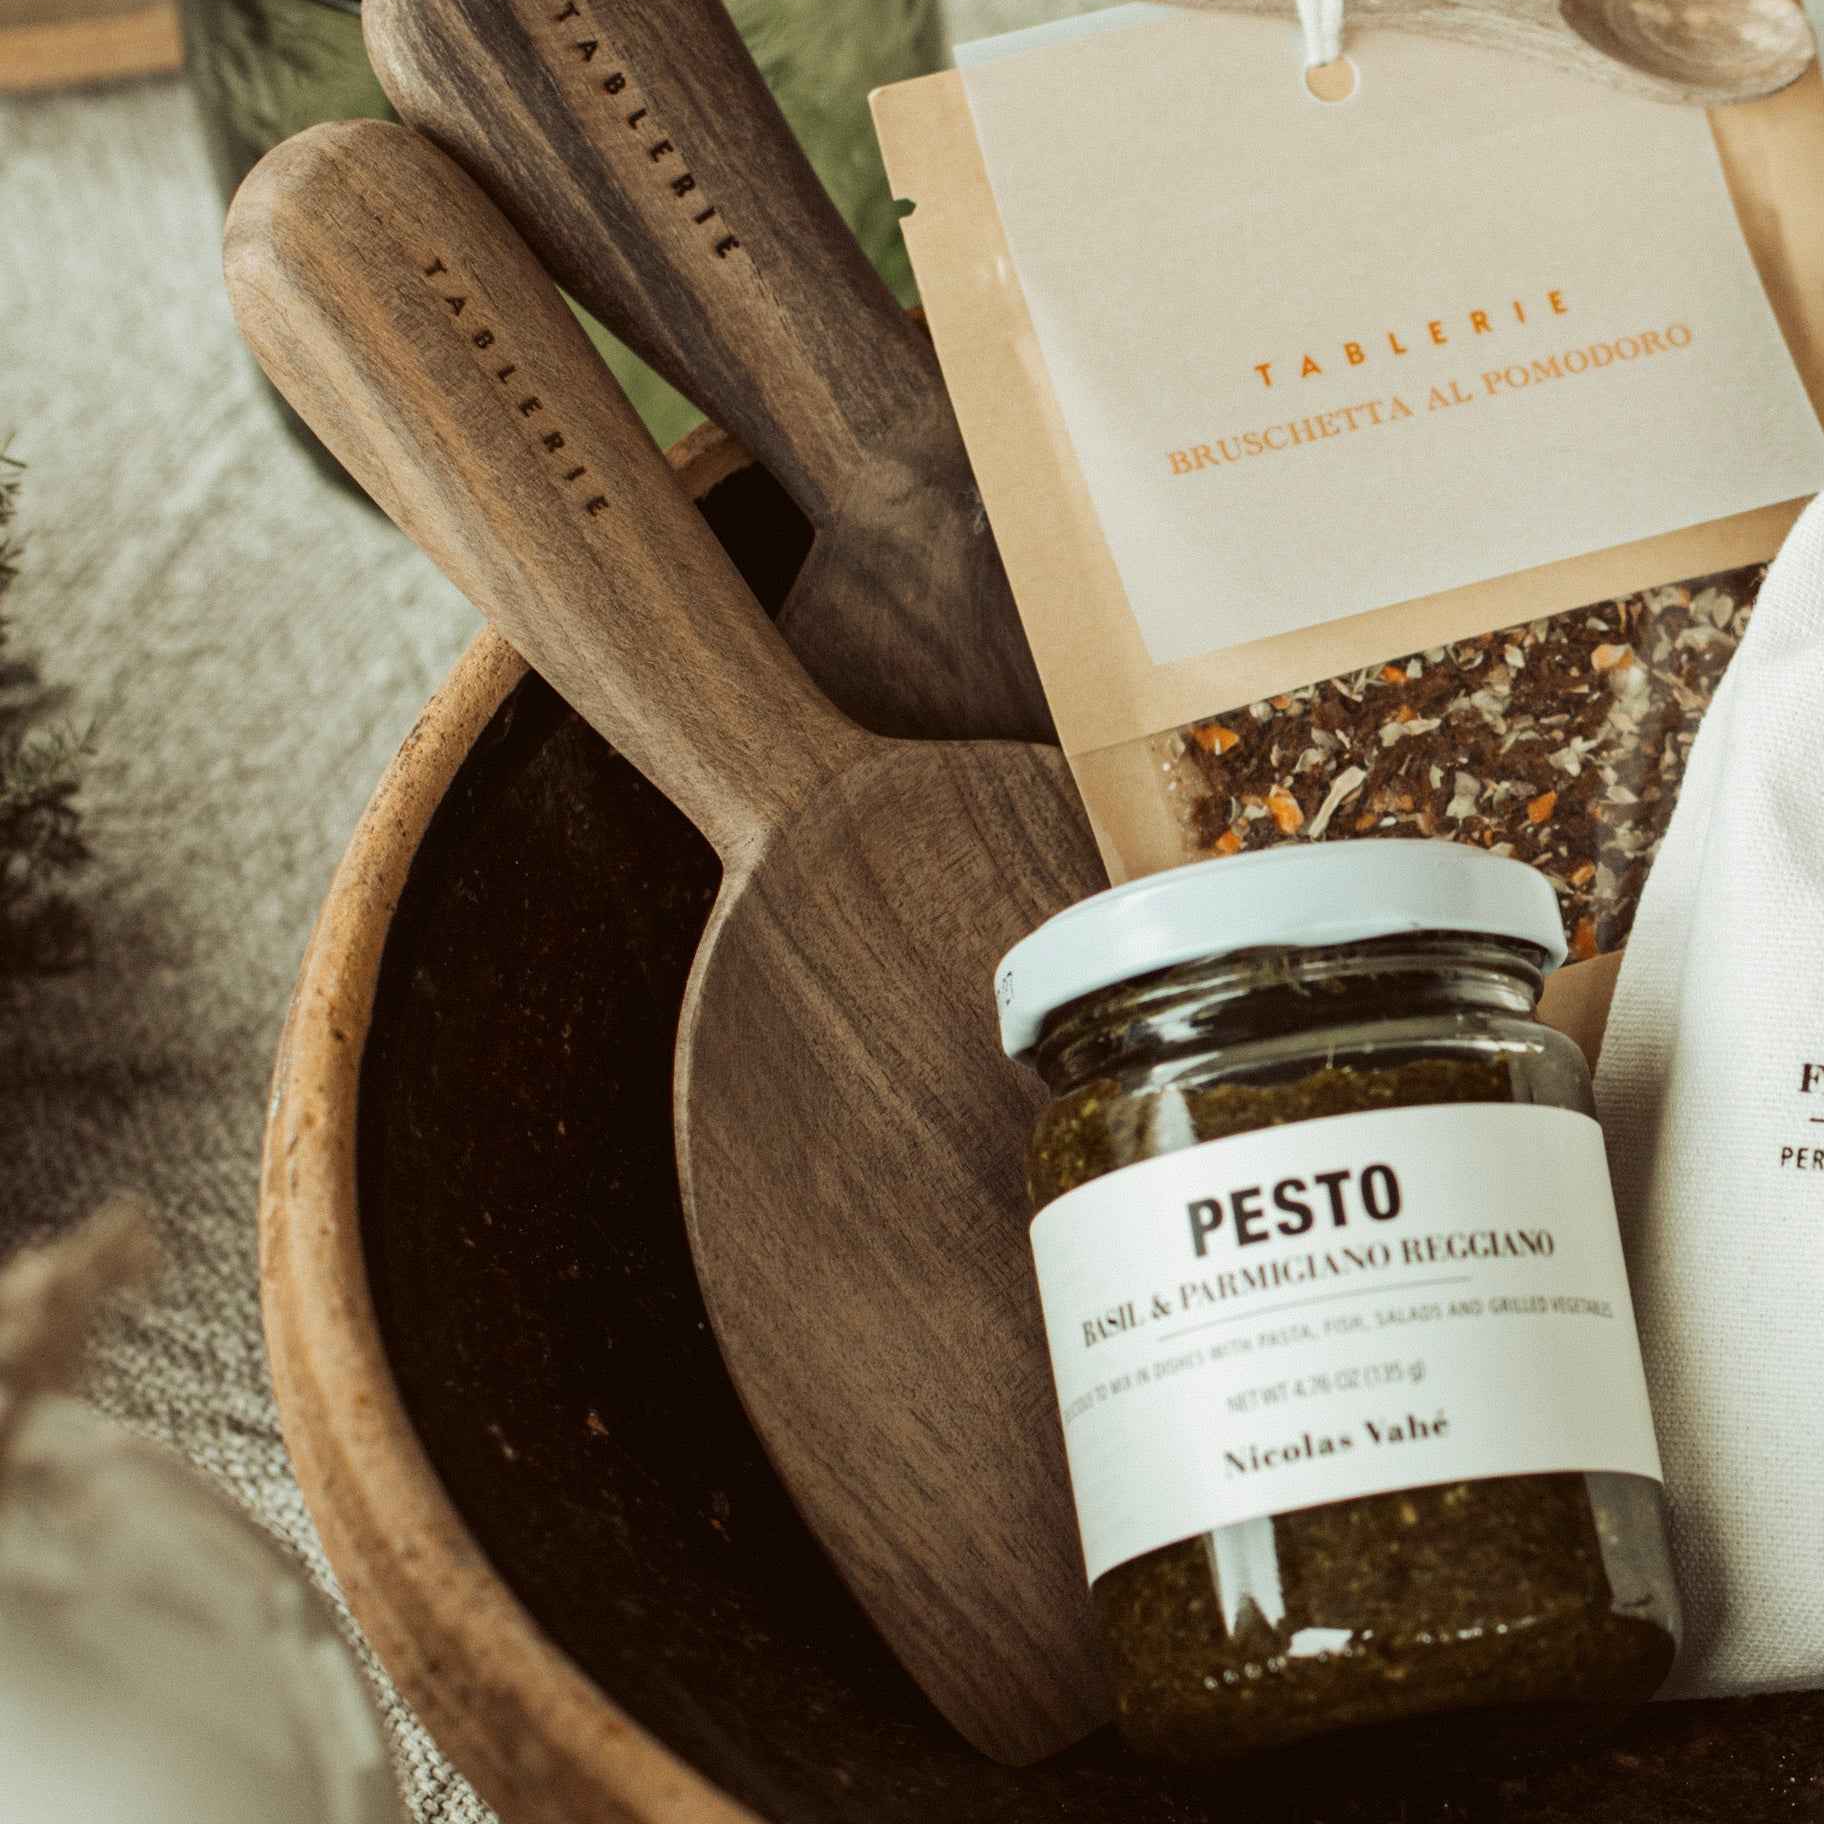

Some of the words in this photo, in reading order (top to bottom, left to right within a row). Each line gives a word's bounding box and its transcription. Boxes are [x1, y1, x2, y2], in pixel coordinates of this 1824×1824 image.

[554, 0, 741, 260] TABLERIE
[424, 257, 609, 517] TABLERIE
[1255, 288, 1571, 389] TABLERIE
[1167, 397, 1417, 477] BRUSCHETTA
[1427, 381, 1475, 415] AL
[1483, 321, 1695, 398] POMODORO
[1186, 1163, 1404, 1259] PESTO
[1081, 1299, 1145, 1348] BASIL
[1150, 1294, 1171, 1320] &
[1178, 1242, 1393, 1313] PARMIGIANO
[1400, 1228, 1555, 1267] REGGIANO
[1447, 1297, 1483, 1318] AND
[1223, 1431, 1355, 1479] Nicolas
[1363, 1407, 1449, 1444] Vahé
